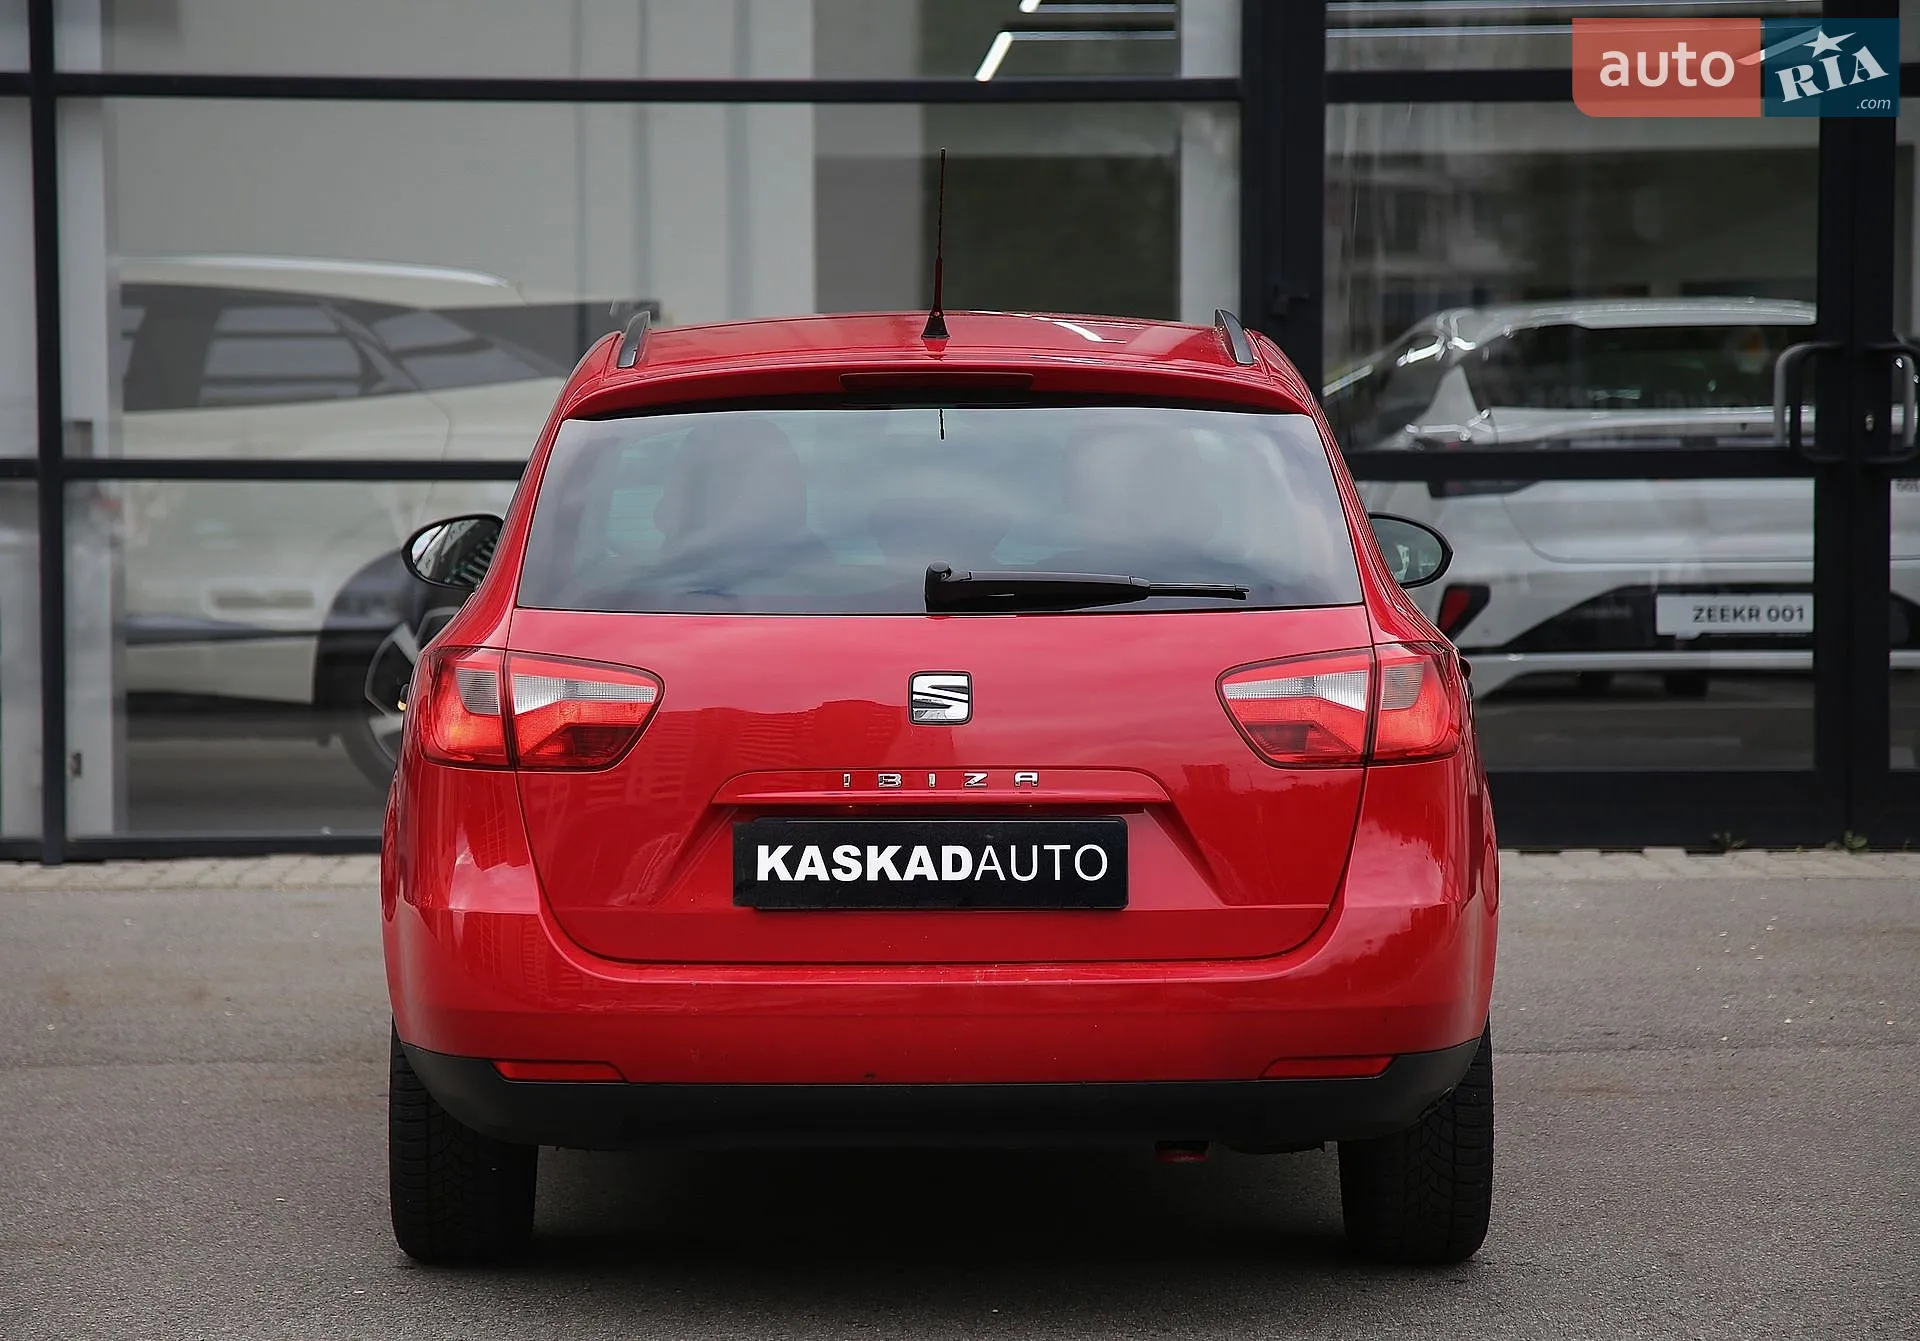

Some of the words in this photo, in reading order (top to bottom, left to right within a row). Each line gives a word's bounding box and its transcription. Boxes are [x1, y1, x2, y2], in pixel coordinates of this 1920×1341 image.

[1692, 605, 1760, 622] ZEEKR
[1767, 605, 1804, 622] 001
[843, 772, 1040, 788] IBIZA
[756, 844, 1109, 881] KASKADAUTO
